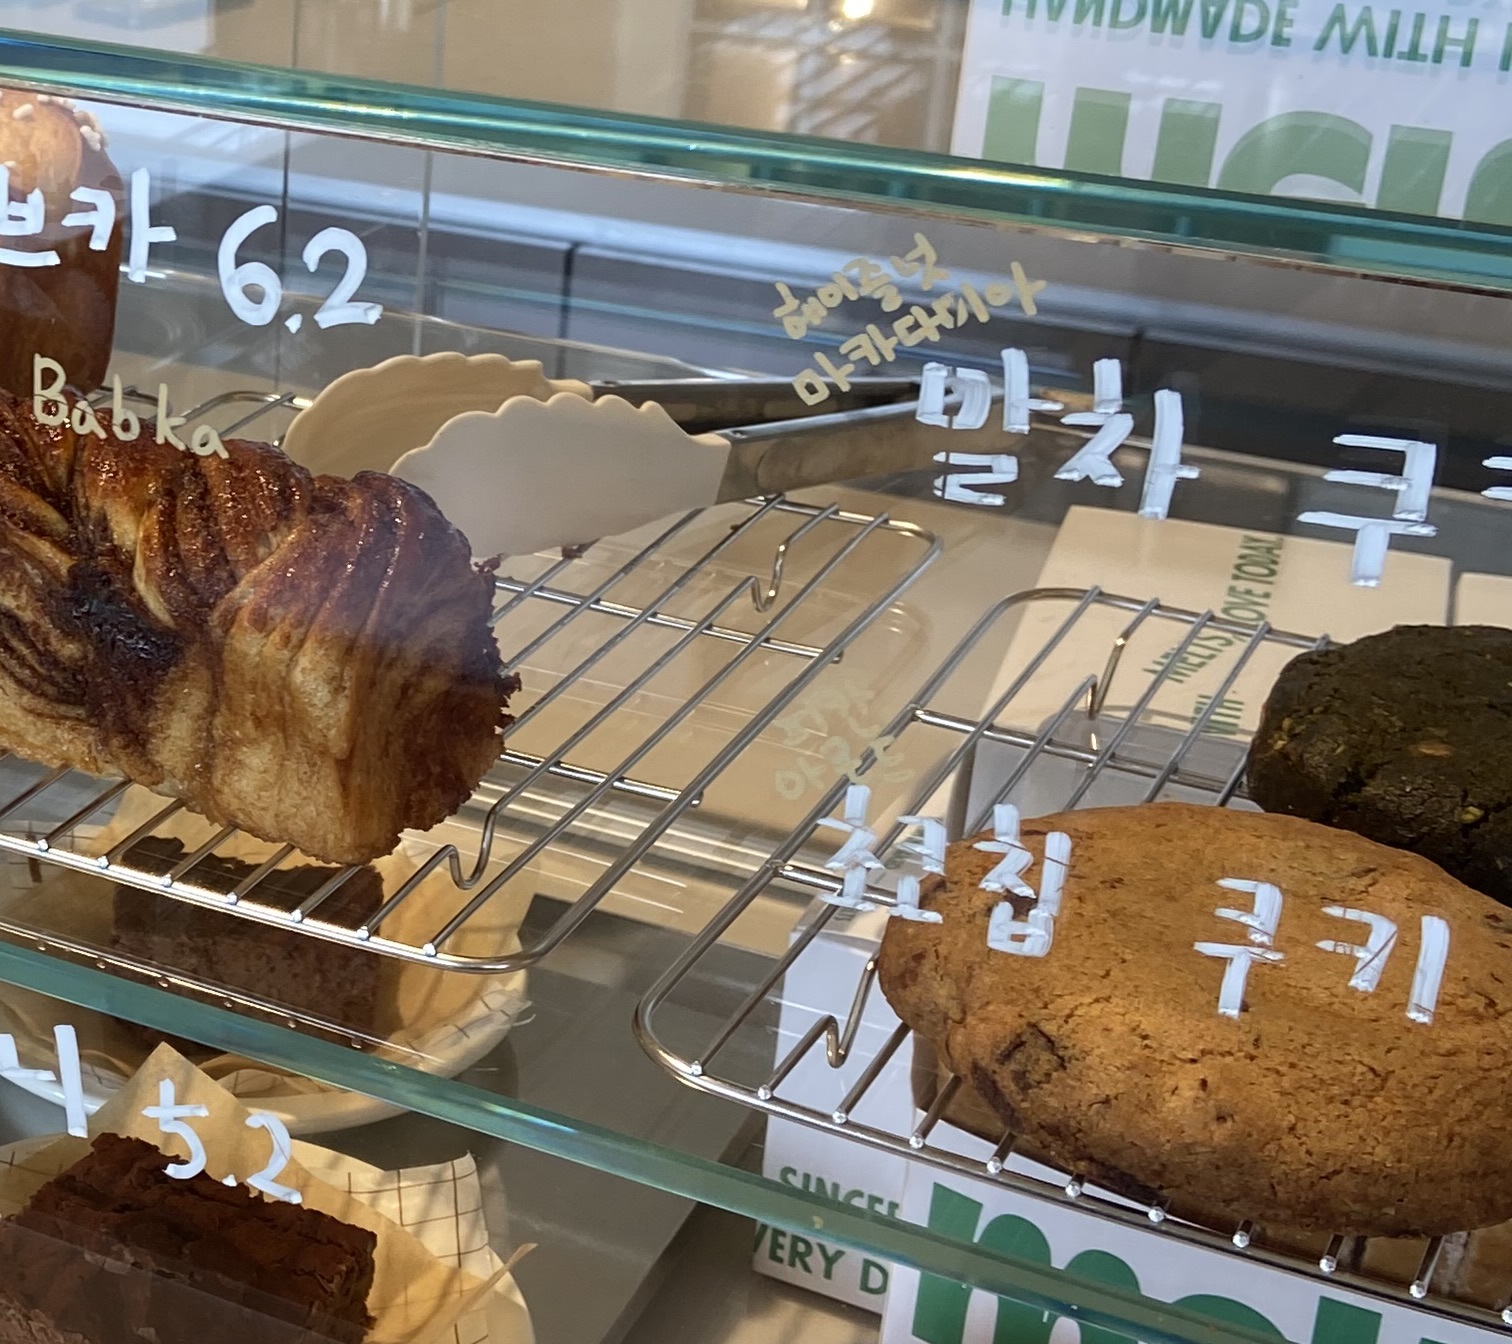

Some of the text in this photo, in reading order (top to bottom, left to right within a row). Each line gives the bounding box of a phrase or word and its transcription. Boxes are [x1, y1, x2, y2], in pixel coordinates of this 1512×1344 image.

[218, 204, 384, 334] 6.2
[33, 353, 230, 459] Babka
[916, 348, 1512, 588] 말차 쿠
[818, 785, 1449, 1024] 초코칩 쿠키
[142, 1078, 302, 1204] 5.2
